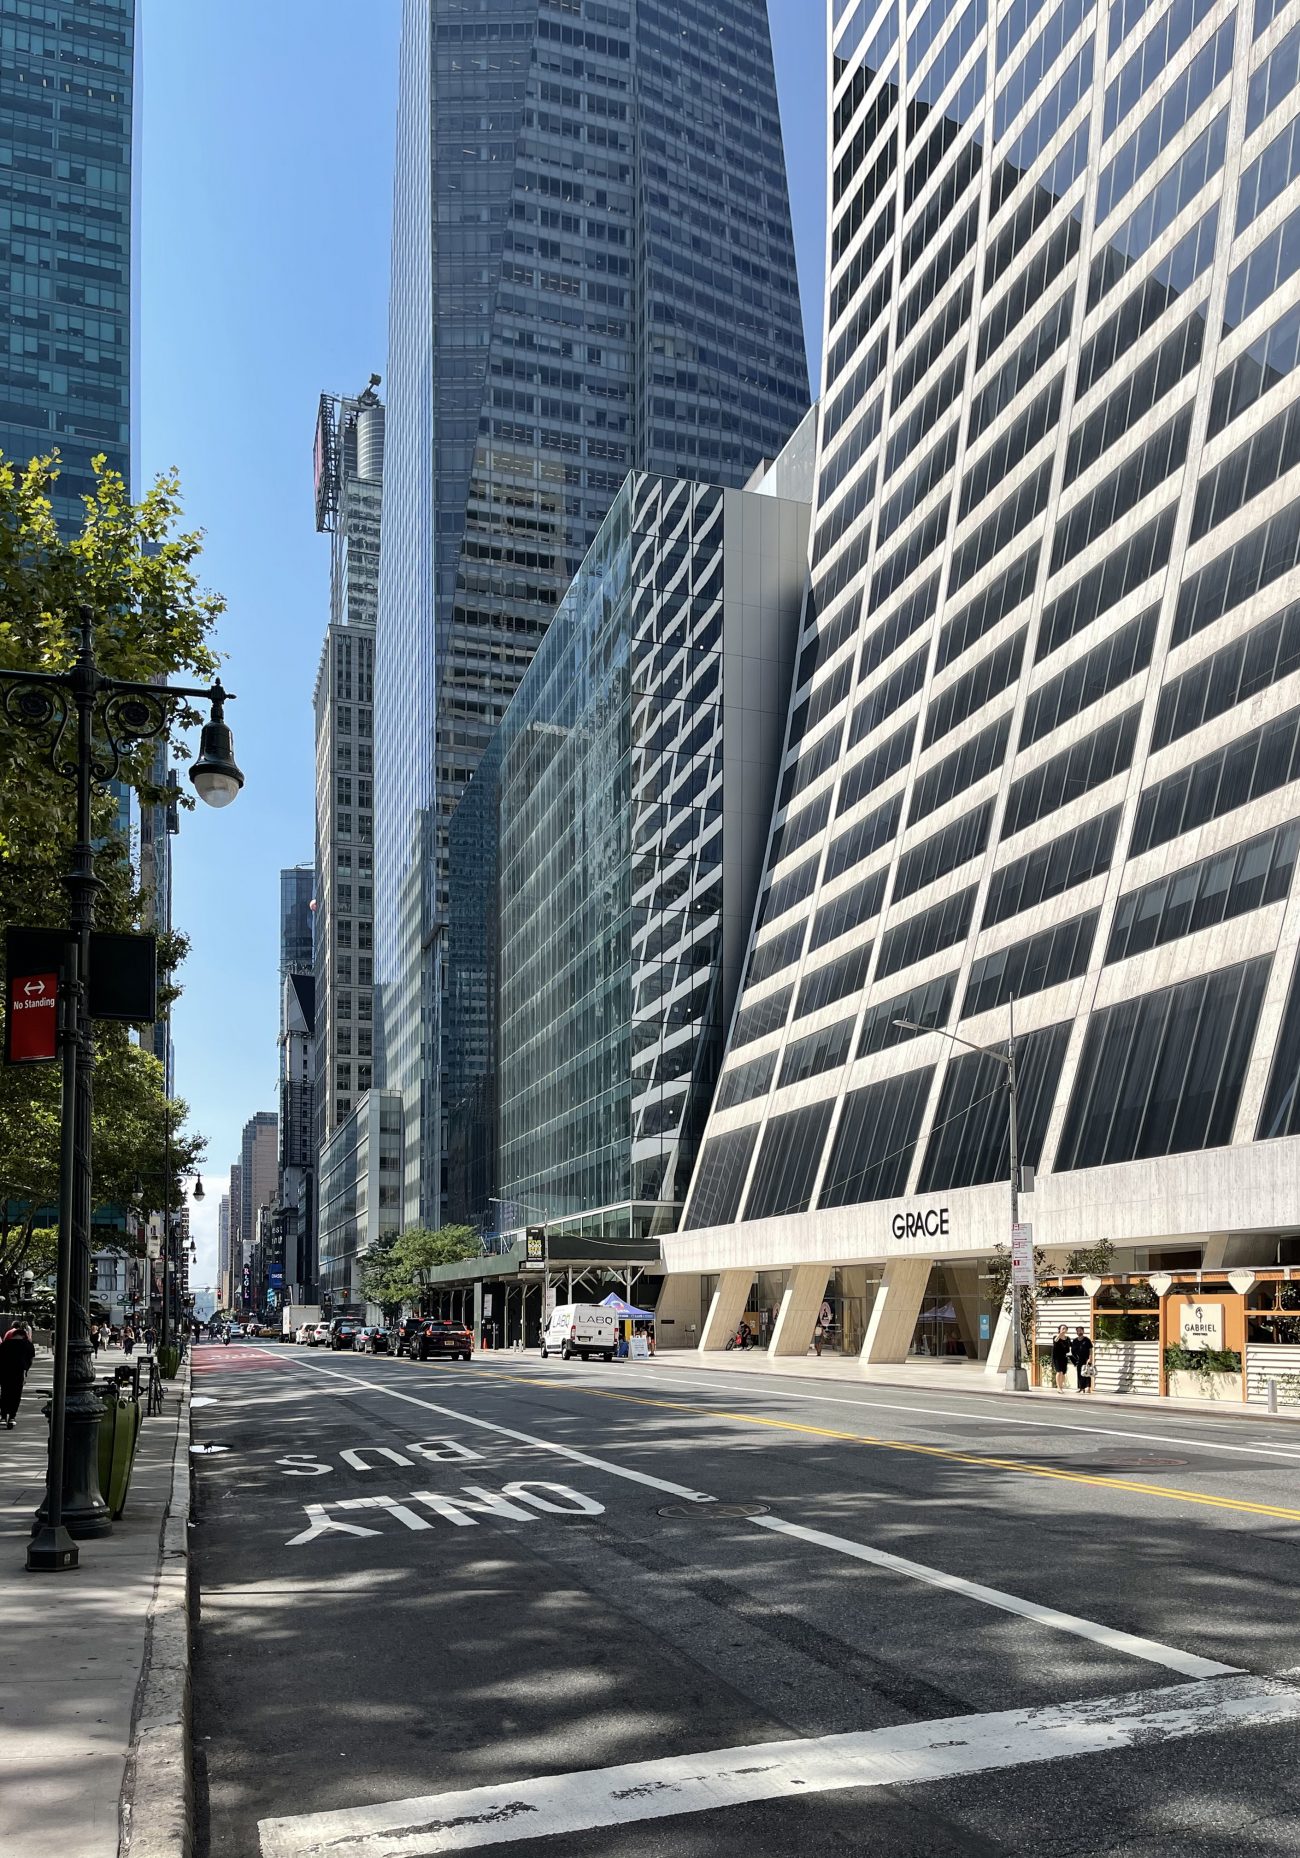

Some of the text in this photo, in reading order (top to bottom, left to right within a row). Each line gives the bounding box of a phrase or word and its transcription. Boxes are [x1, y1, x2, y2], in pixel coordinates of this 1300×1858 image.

[13, 996, 55, 1010] No Standing
[892, 1208, 949, 1240] GRACE
[578, 1315, 613, 1325] LABQ
[1184, 1323, 1217, 1332] GABRIEL
[275, 1440, 486, 1476] BUS
[284, 1481, 606, 1546] ONLY
